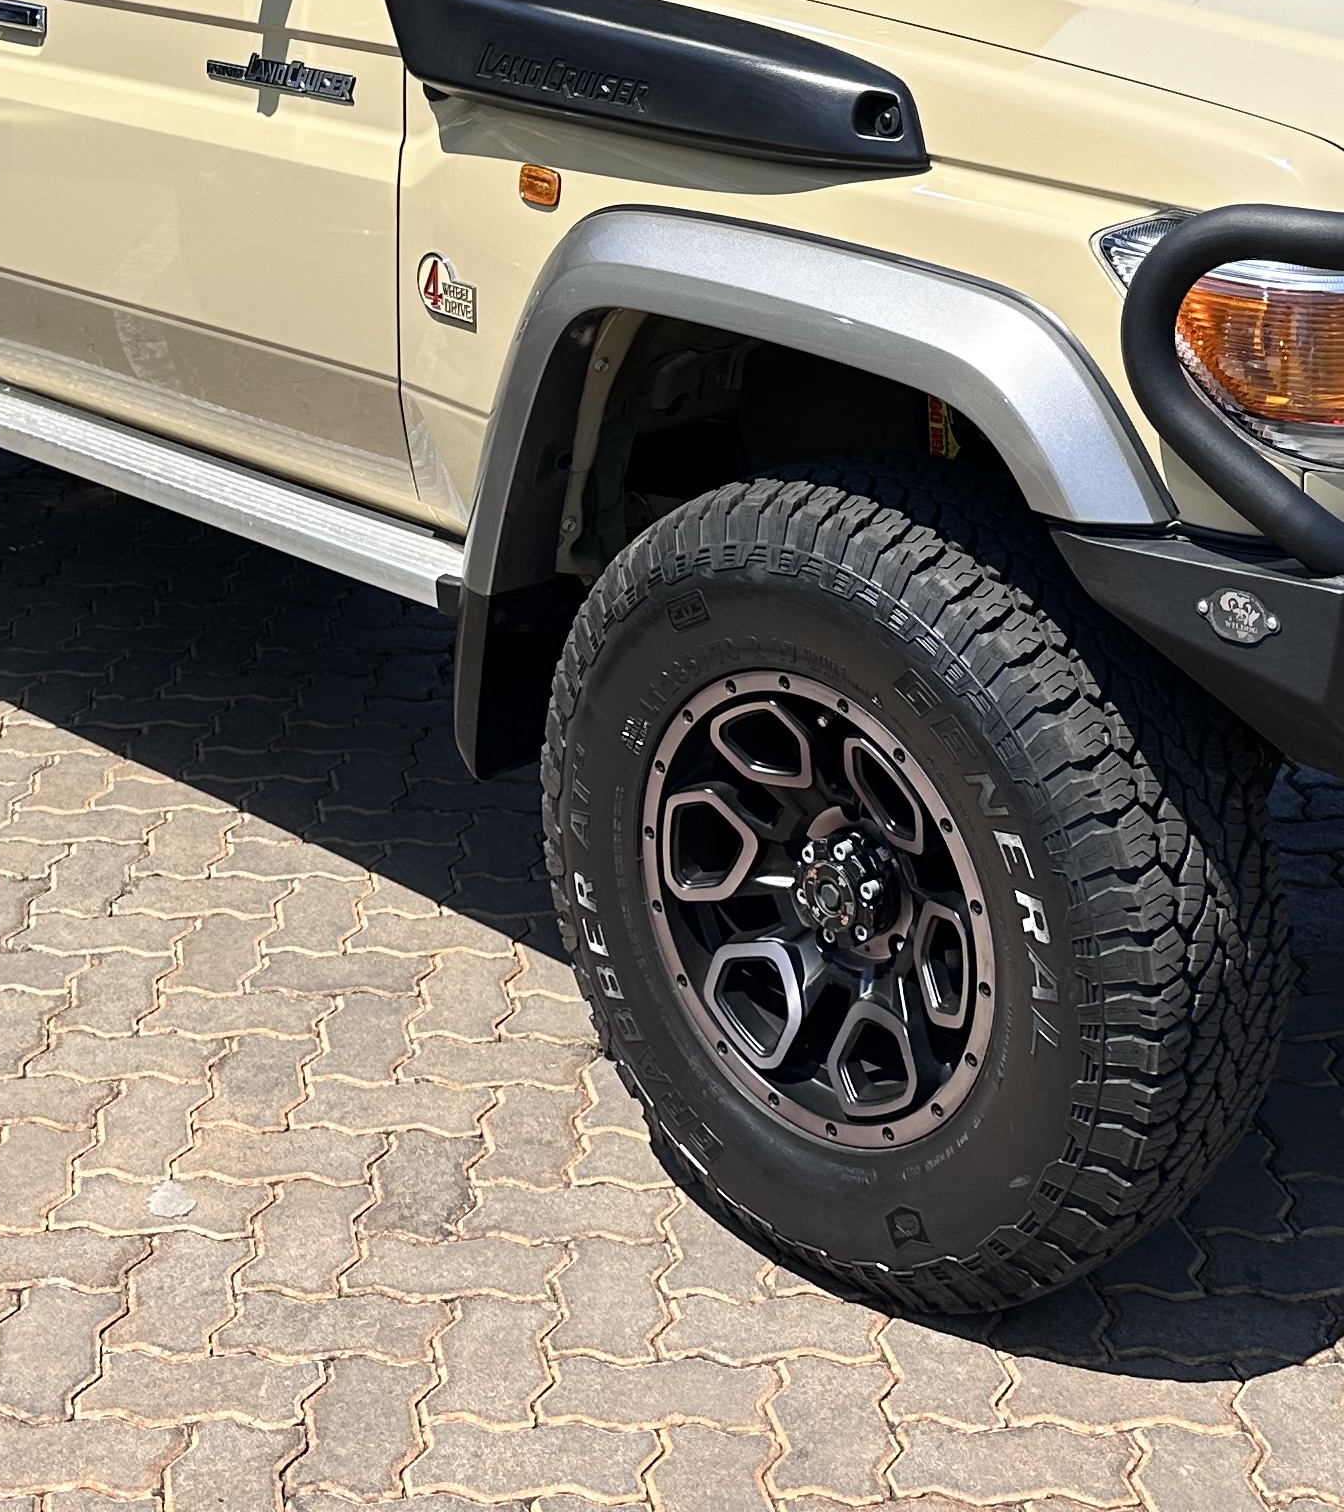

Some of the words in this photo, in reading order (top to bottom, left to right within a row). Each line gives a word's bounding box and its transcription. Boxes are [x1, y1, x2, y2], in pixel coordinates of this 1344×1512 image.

[423, 259, 444, 311] 4
[442, 281, 473, 304] WHEEL
[444, 297, 474, 320] DRIVE
[892, 668, 1061, 1057] GENERAL
[572, 869, 726, 1164] GRABBER
